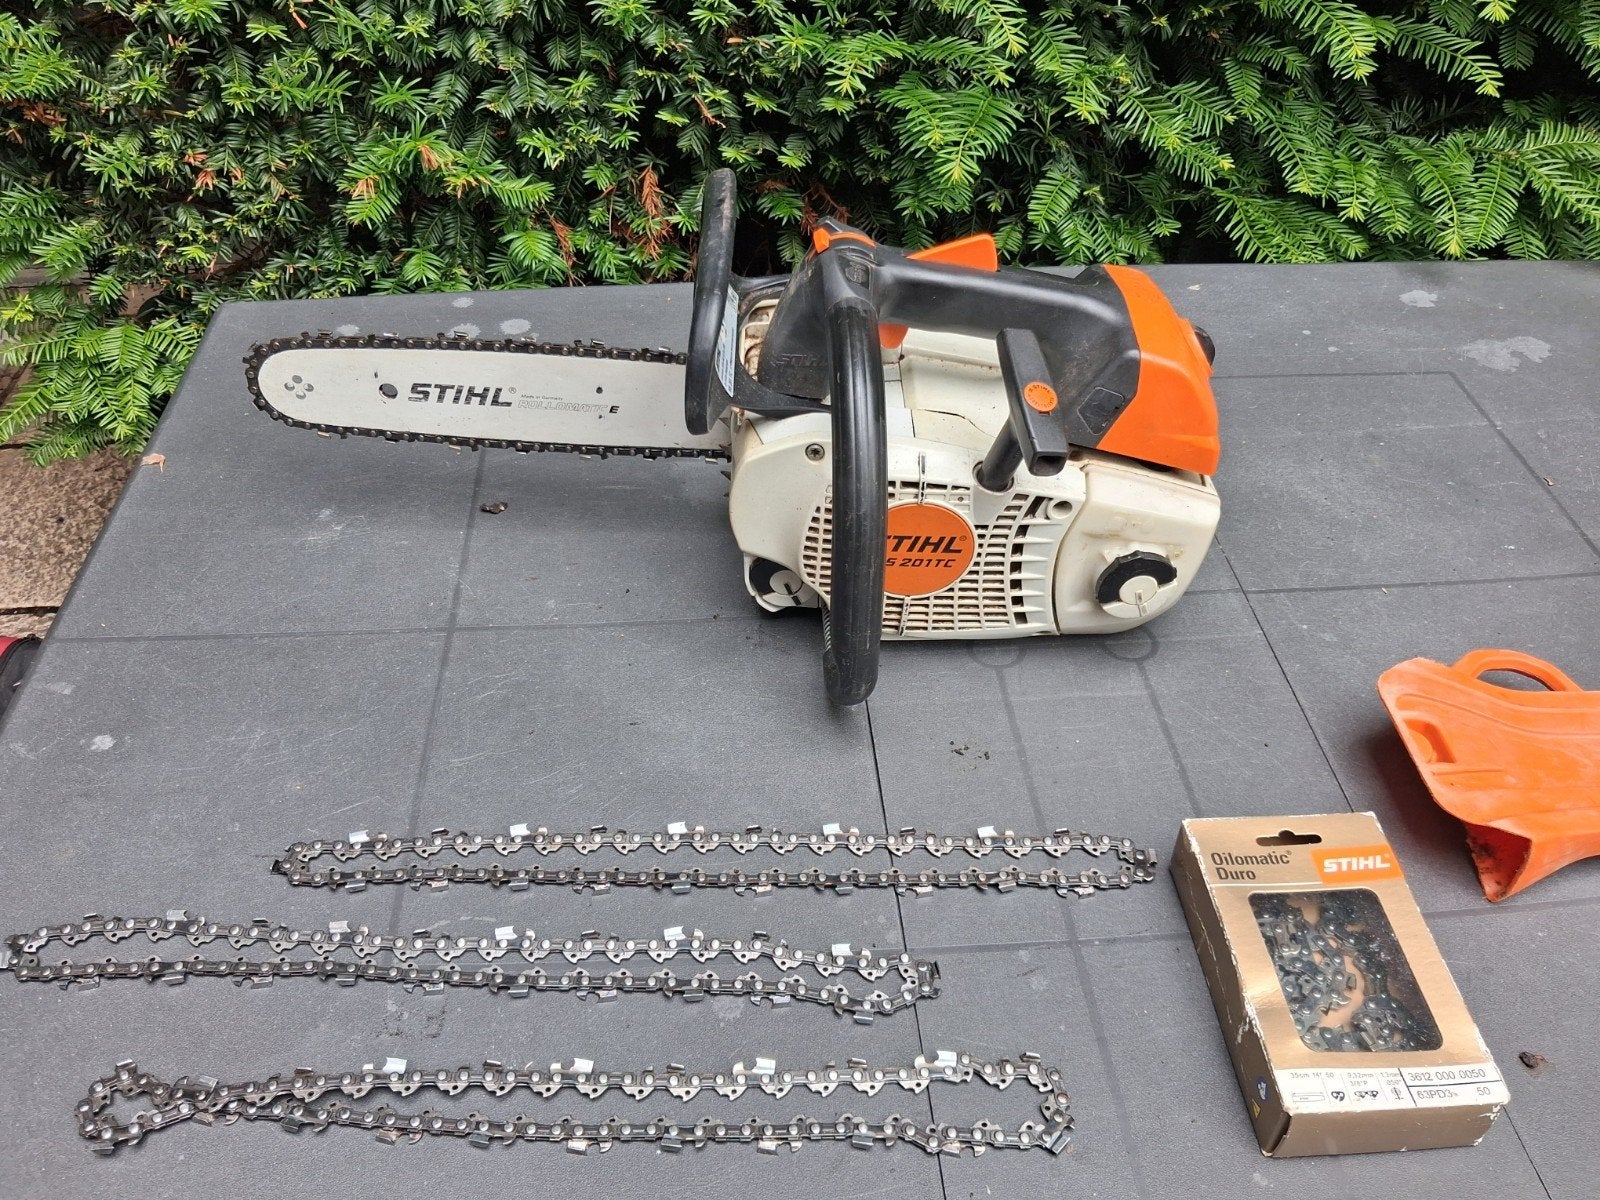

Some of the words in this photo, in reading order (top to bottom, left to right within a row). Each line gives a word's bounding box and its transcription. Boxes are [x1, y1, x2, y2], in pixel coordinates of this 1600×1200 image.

[408, 382, 512, 407] STIHL
[609, 405, 620, 414] E
[887, 535, 963, 553] TIHL
[899, 558, 957, 567] 201TC
[1211, 850, 1290, 866] Oilomatic
[1324, 854, 1390, 873] STIHL
[1216, 867, 1256, 880] Duro
[1408, 1072, 1433, 1081] 3612
[1435, 1071, 1455, 1080] 000
[1459, 1069, 1486, 1079] 0050
[1477, 1086, 1491, 1096] 50
